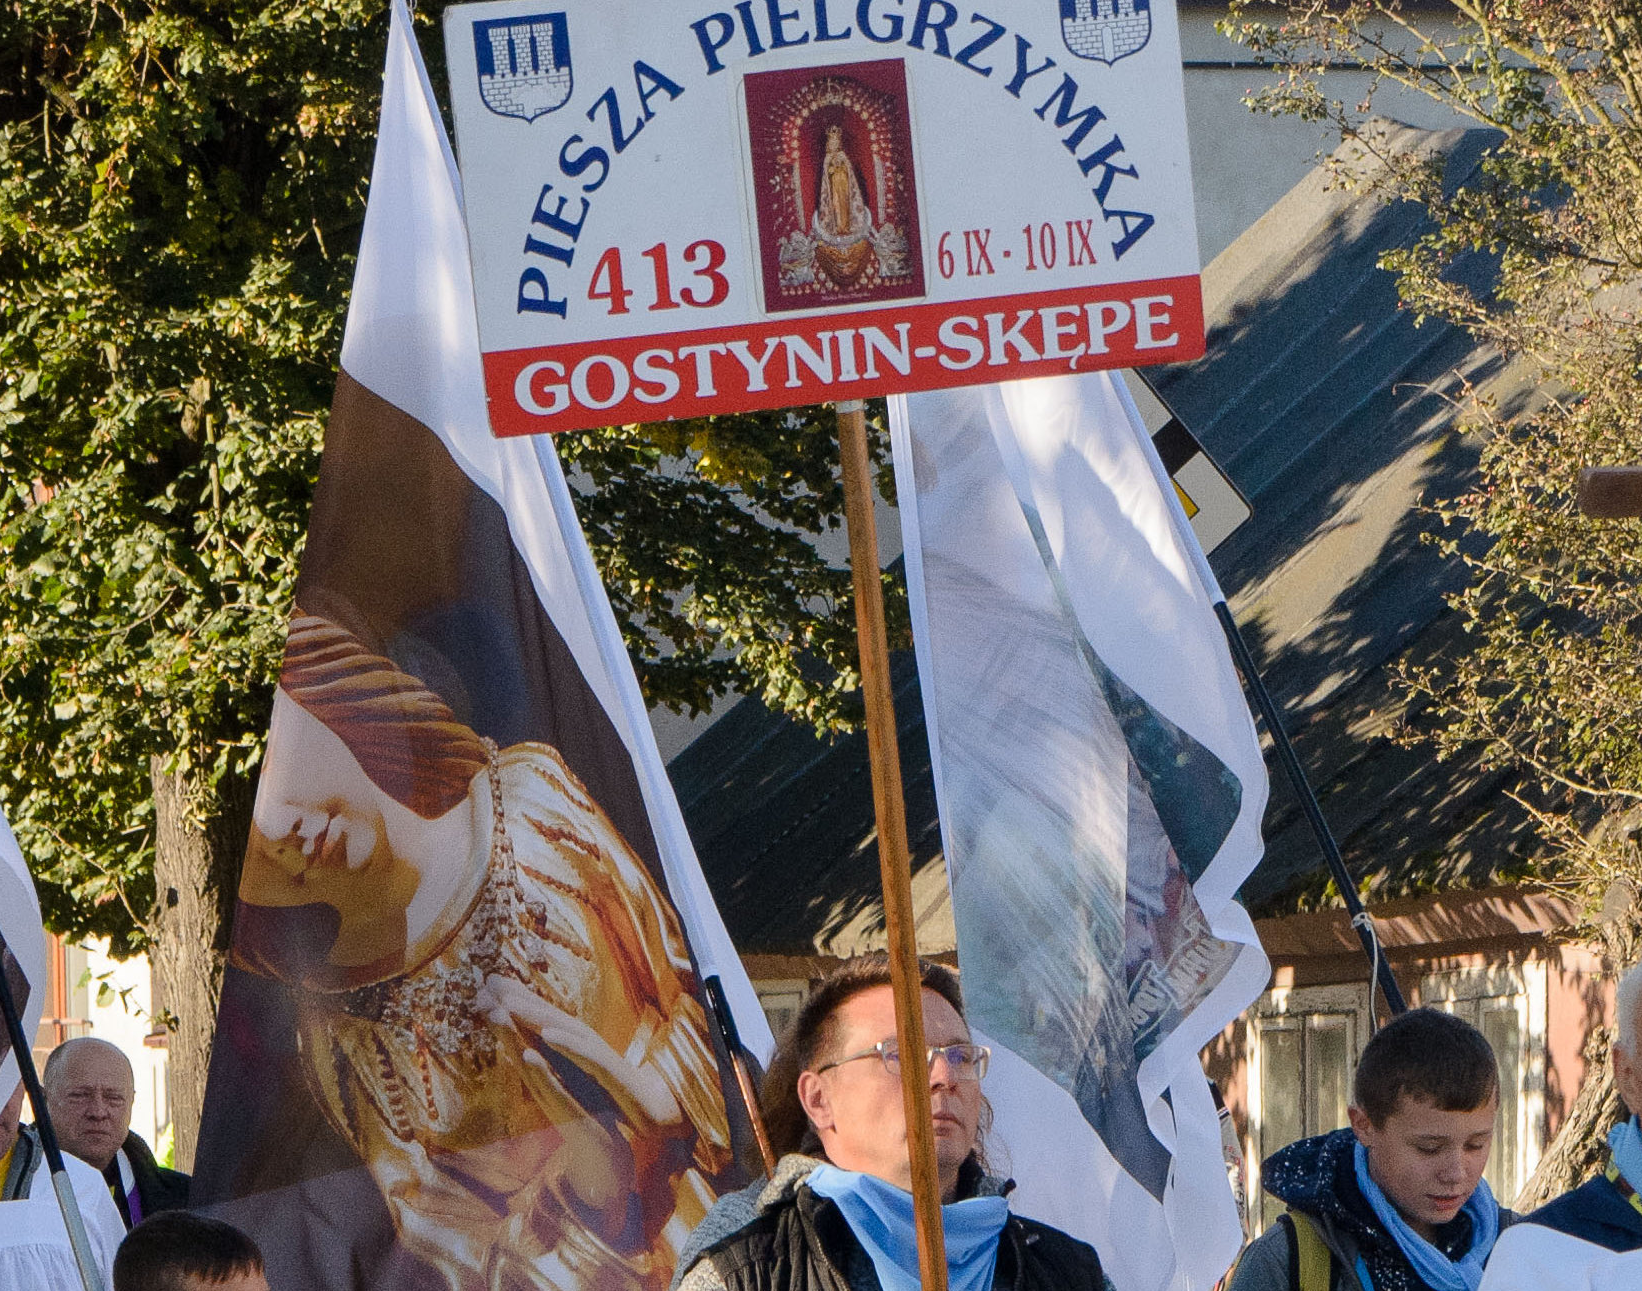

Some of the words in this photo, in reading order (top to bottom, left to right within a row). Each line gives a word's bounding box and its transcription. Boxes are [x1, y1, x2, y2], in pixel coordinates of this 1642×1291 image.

[517, 60, 685, 320] PIESZA
[689, 0, 1155, 261] PIELGRZYMKA
[588, 239, 730, 315] 413
[938, 231, 954, 279] 6
[963, 229, 995, 276] IX
[1022, 222, 1057, 270] 10
[1065, 219, 1097, 266] IX
[514, 294, 1179, 416] GOSTYNIN-SKĘPE
